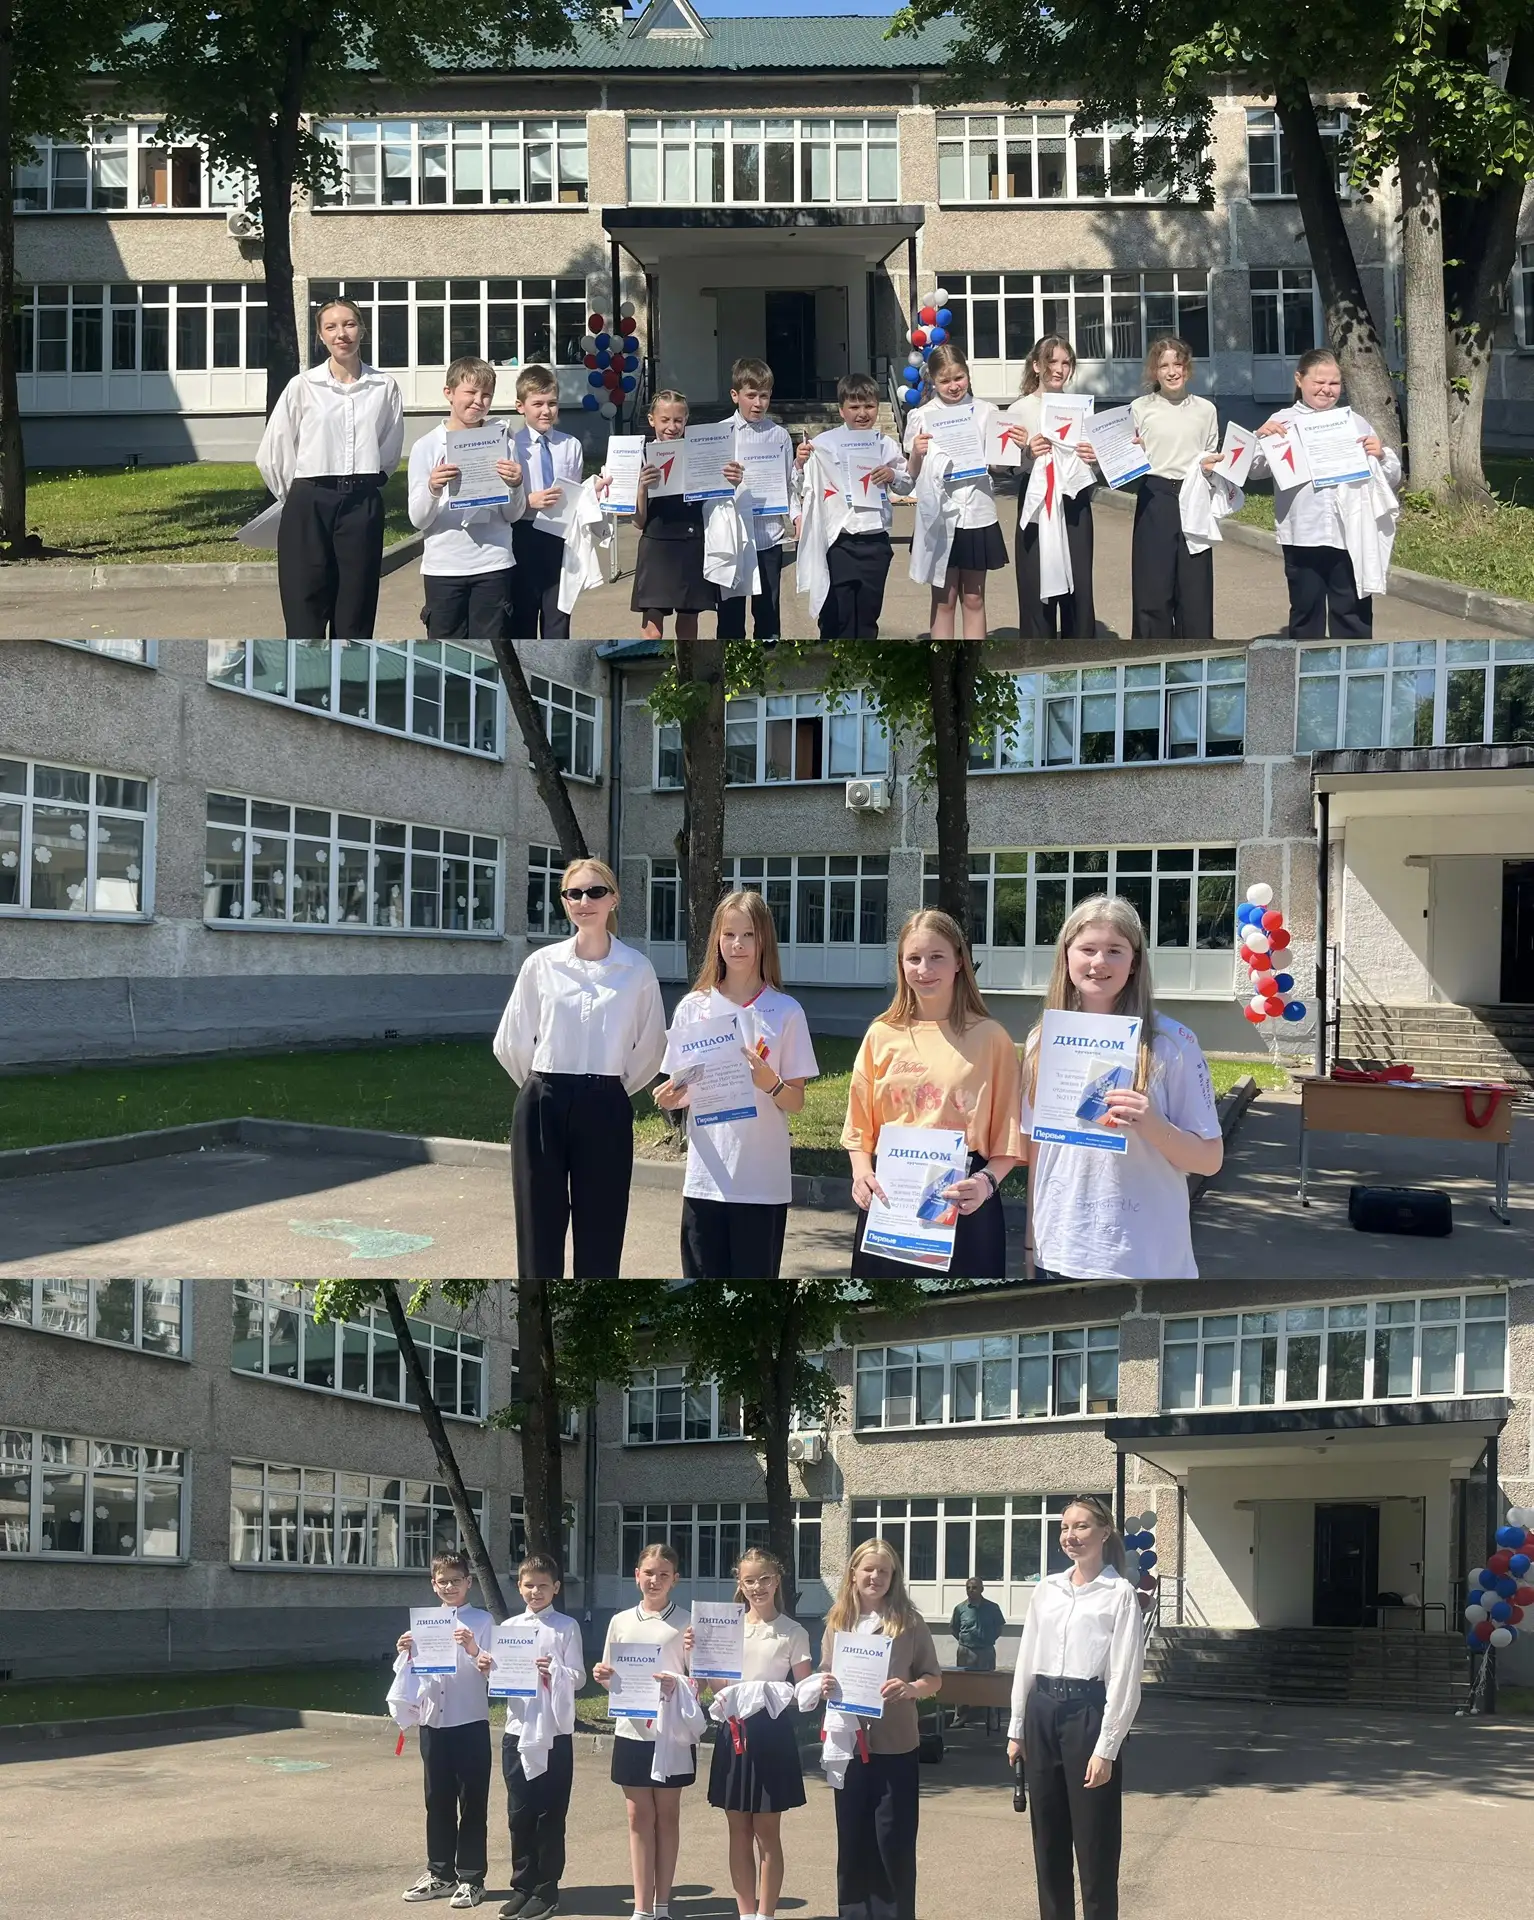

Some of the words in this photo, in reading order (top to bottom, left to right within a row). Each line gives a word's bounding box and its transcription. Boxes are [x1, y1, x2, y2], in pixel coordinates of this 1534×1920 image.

[932, 416, 972, 428] СЕРТИФИКАТ
[454, 439, 500, 449] СЕРТИФИКАТ
[690, 435, 730, 443] СЕРТИФИКАТ
[681, 1033, 736, 1053] ДИПЛОМ
[1053, 1035, 1125, 1050] ДИПЛОМ
[696, 1115, 719, 1124] Первые
[1035, 1129, 1066, 1141] Первые
[887, 1148, 952, 1161] ДИПЛОМ
[1121, 1196, 1141, 1213] the
[868, 1232, 897, 1245] Первые
[416, 1618, 451, 1626] ДИПЛОМ
[698, 1617, 738, 1625] ДИПЛОМ
[841, 1646, 884, 1657] ДИПЛОМ
